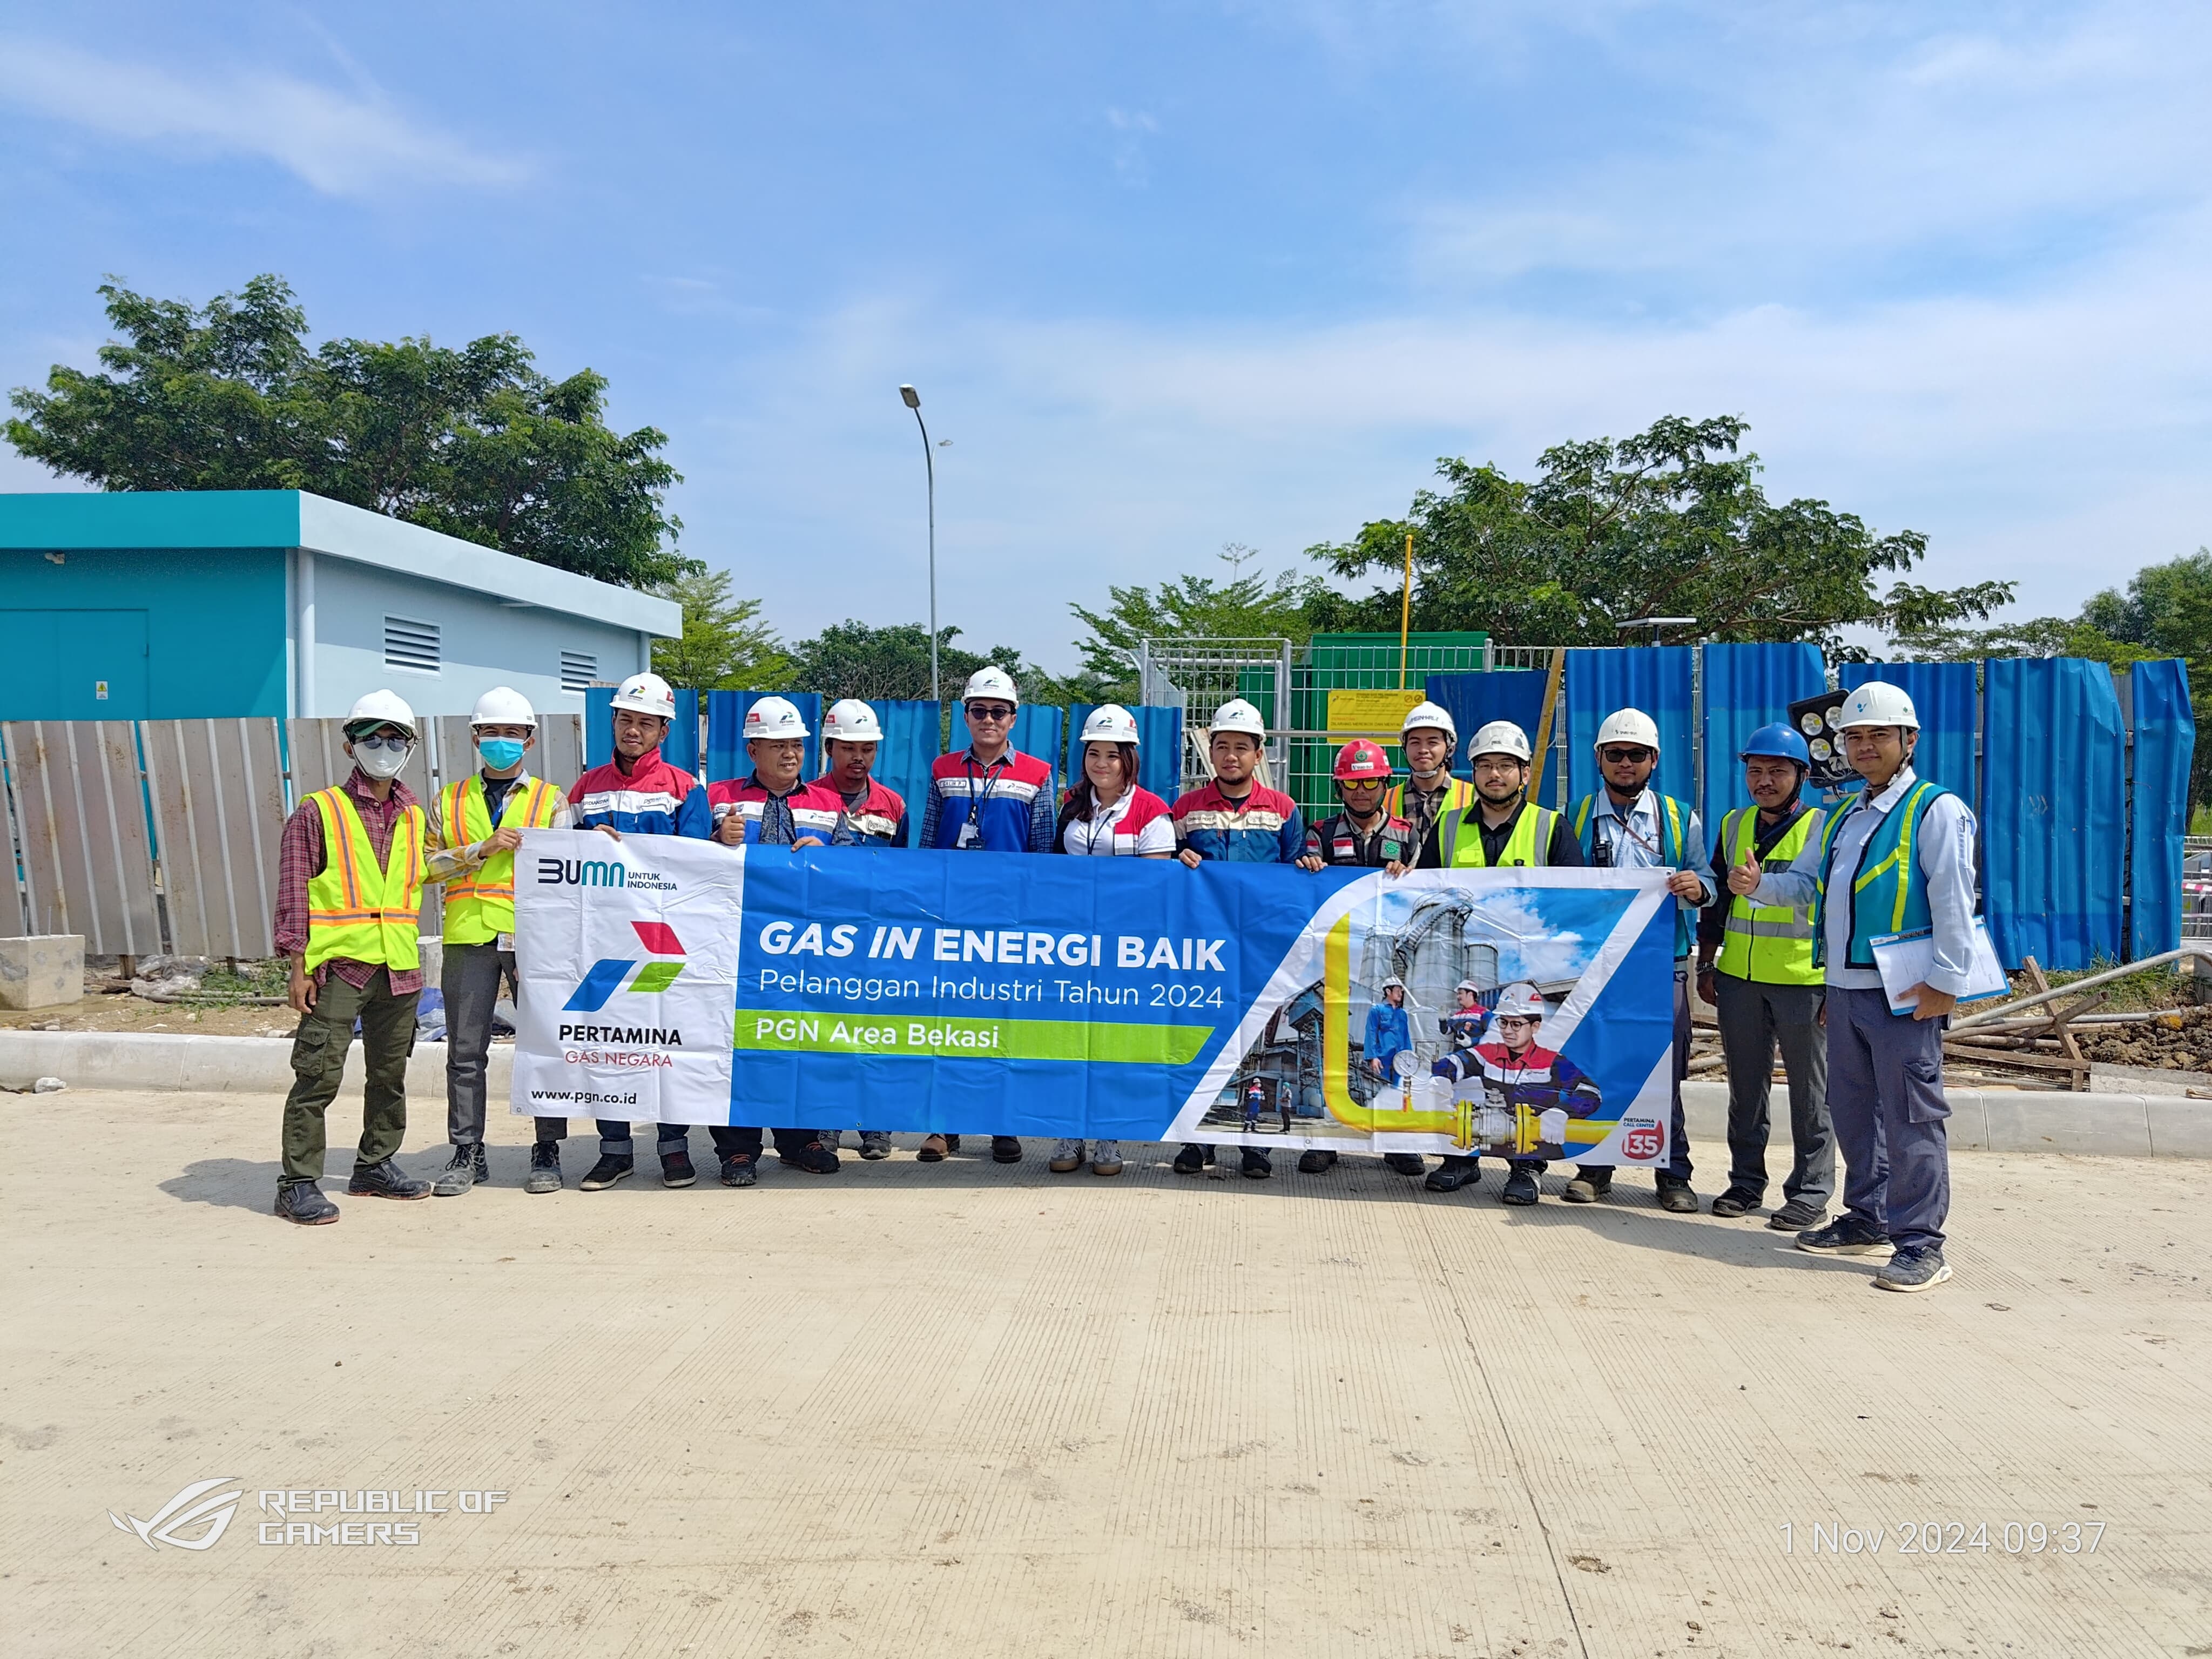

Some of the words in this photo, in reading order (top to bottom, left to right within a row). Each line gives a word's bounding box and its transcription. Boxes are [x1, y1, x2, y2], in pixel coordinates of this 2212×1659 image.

[627, 880, 678, 891] INDONESIA
[628, 871, 660, 881] UNTUK
[759, 920, 859, 958] GAS
[867, 925, 922, 960] IN
[933, 928, 1101, 968] ENERGI
[1116, 935, 1226, 972] BAIK
[759, 968, 920, 1002] Pelanggan
[932, 975, 1043, 1002] Industri
[1054, 979, 1139, 1006] Tahun
[1149, 983, 1225, 1009] 2024
[558, 1024, 683, 1046] PERTAMINA
[756, 1018, 819, 1042] PGN
[828, 1021, 897, 1046] Area
[907, 1023, 999, 1049] Bekasi
[565, 1050, 599, 1064] GAS
[605, 1052, 673, 1068] NEGARA
[531, 1089, 637, 1105] www.pgn.co.id
[1623, 1134, 1658, 1155] 135
